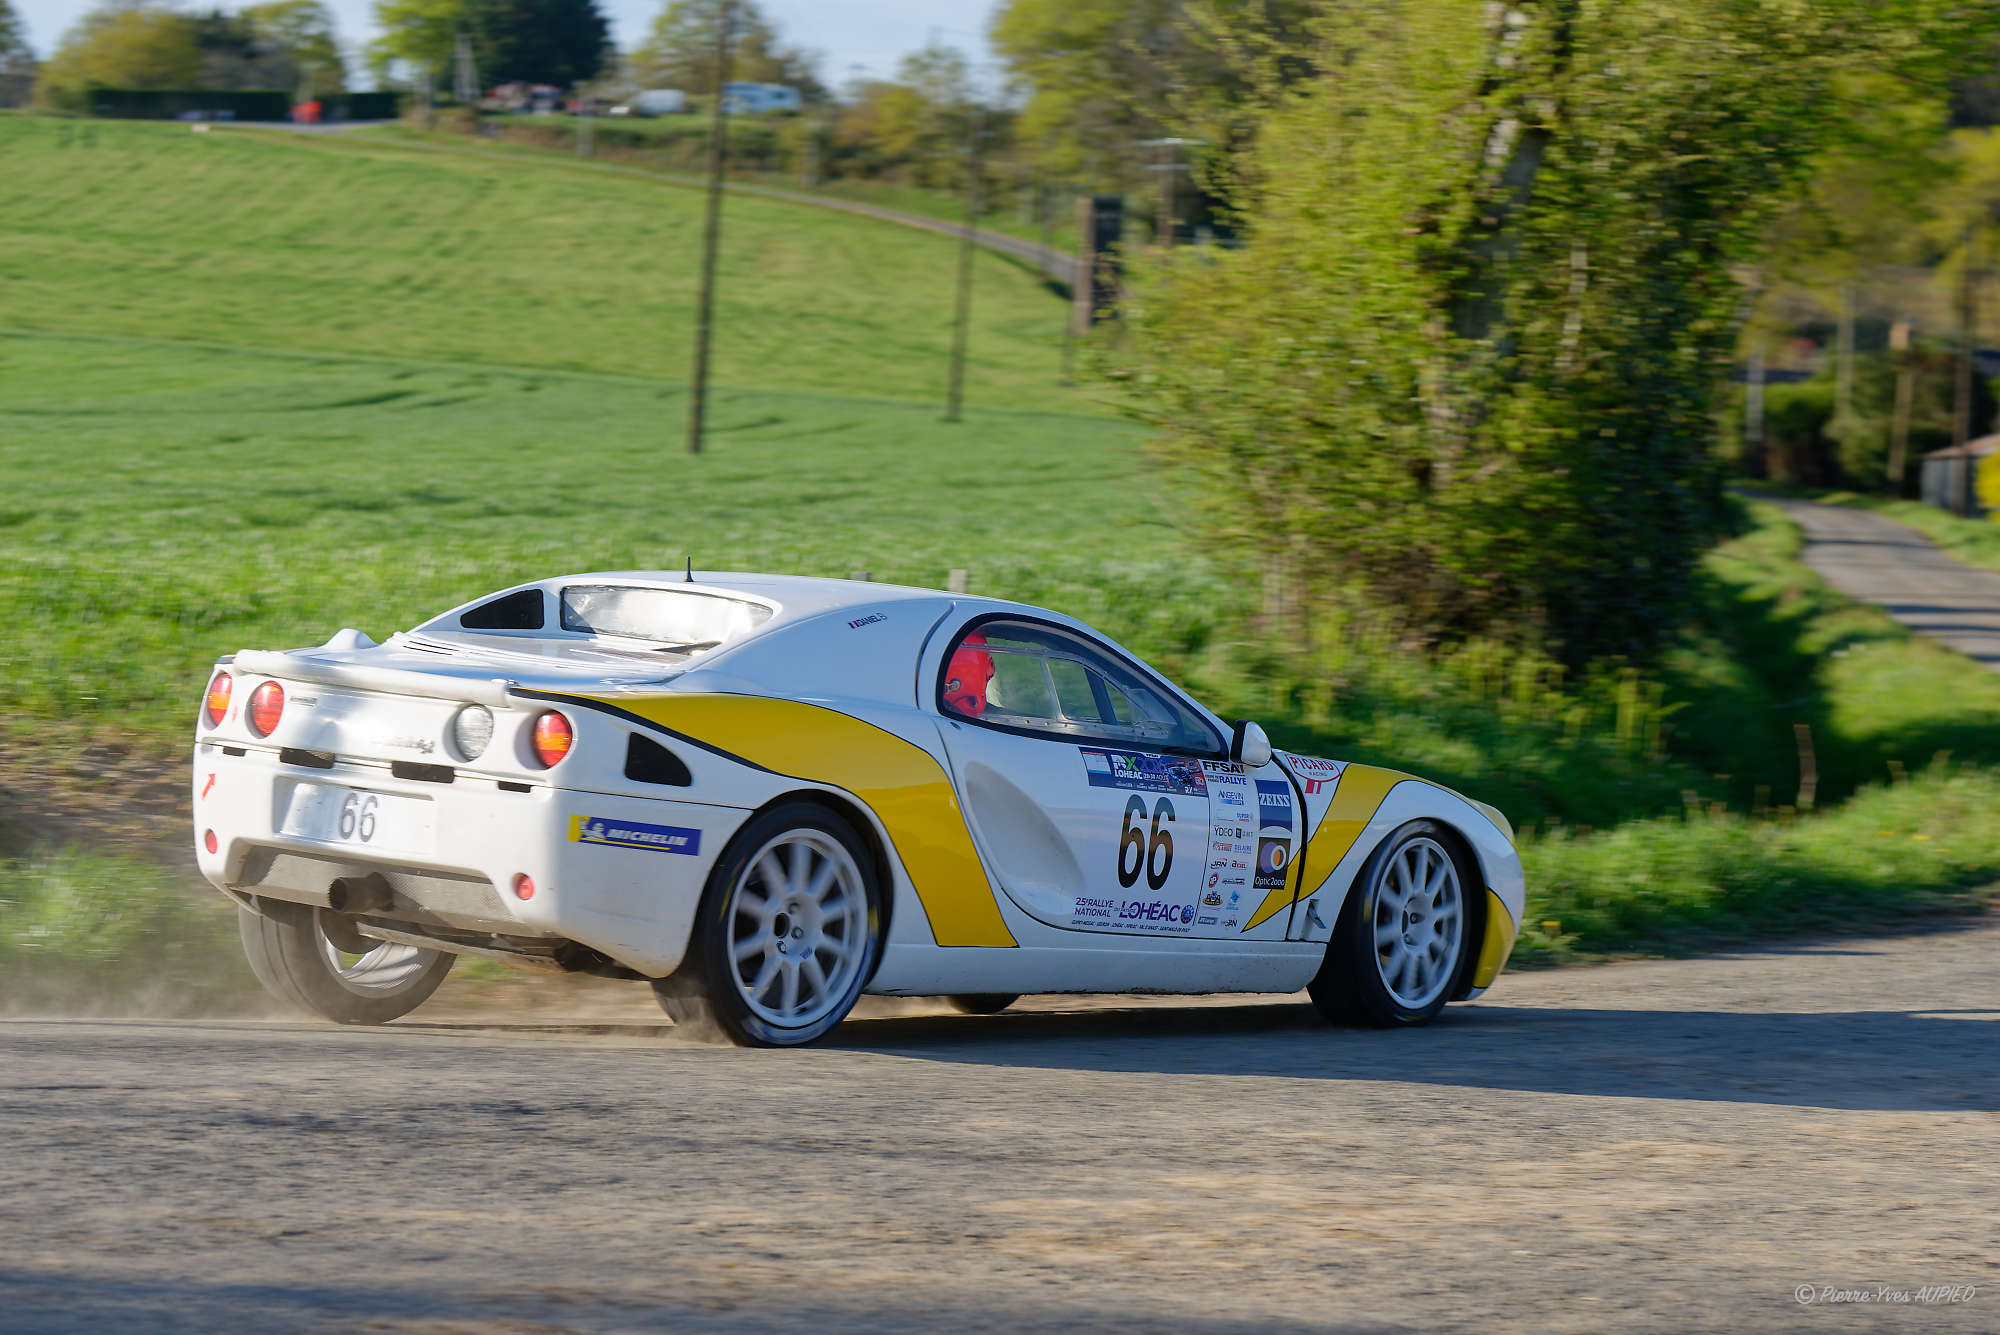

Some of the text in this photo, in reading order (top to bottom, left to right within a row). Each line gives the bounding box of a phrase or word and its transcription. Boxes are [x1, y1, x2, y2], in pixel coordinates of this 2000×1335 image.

[1202, 760, 1241, 774] FFSA
[1289, 756, 1335, 771] PICARD
[1114, 769, 1143, 780] LOHEAC
[1219, 775, 1247, 786] RALLYE
[1258, 793, 1291, 808] ZEISS
[338, 792, 379, 843] 66
[606, 828, 689, 847] MICHELIN
[1118, 794, 1176, 891] 66
[1087, 898, 1114, 908] RALLYE
[1074, 907, 1111, 918] NATIONAL
[1119, 900, 1181, 922] LOHÉAC
